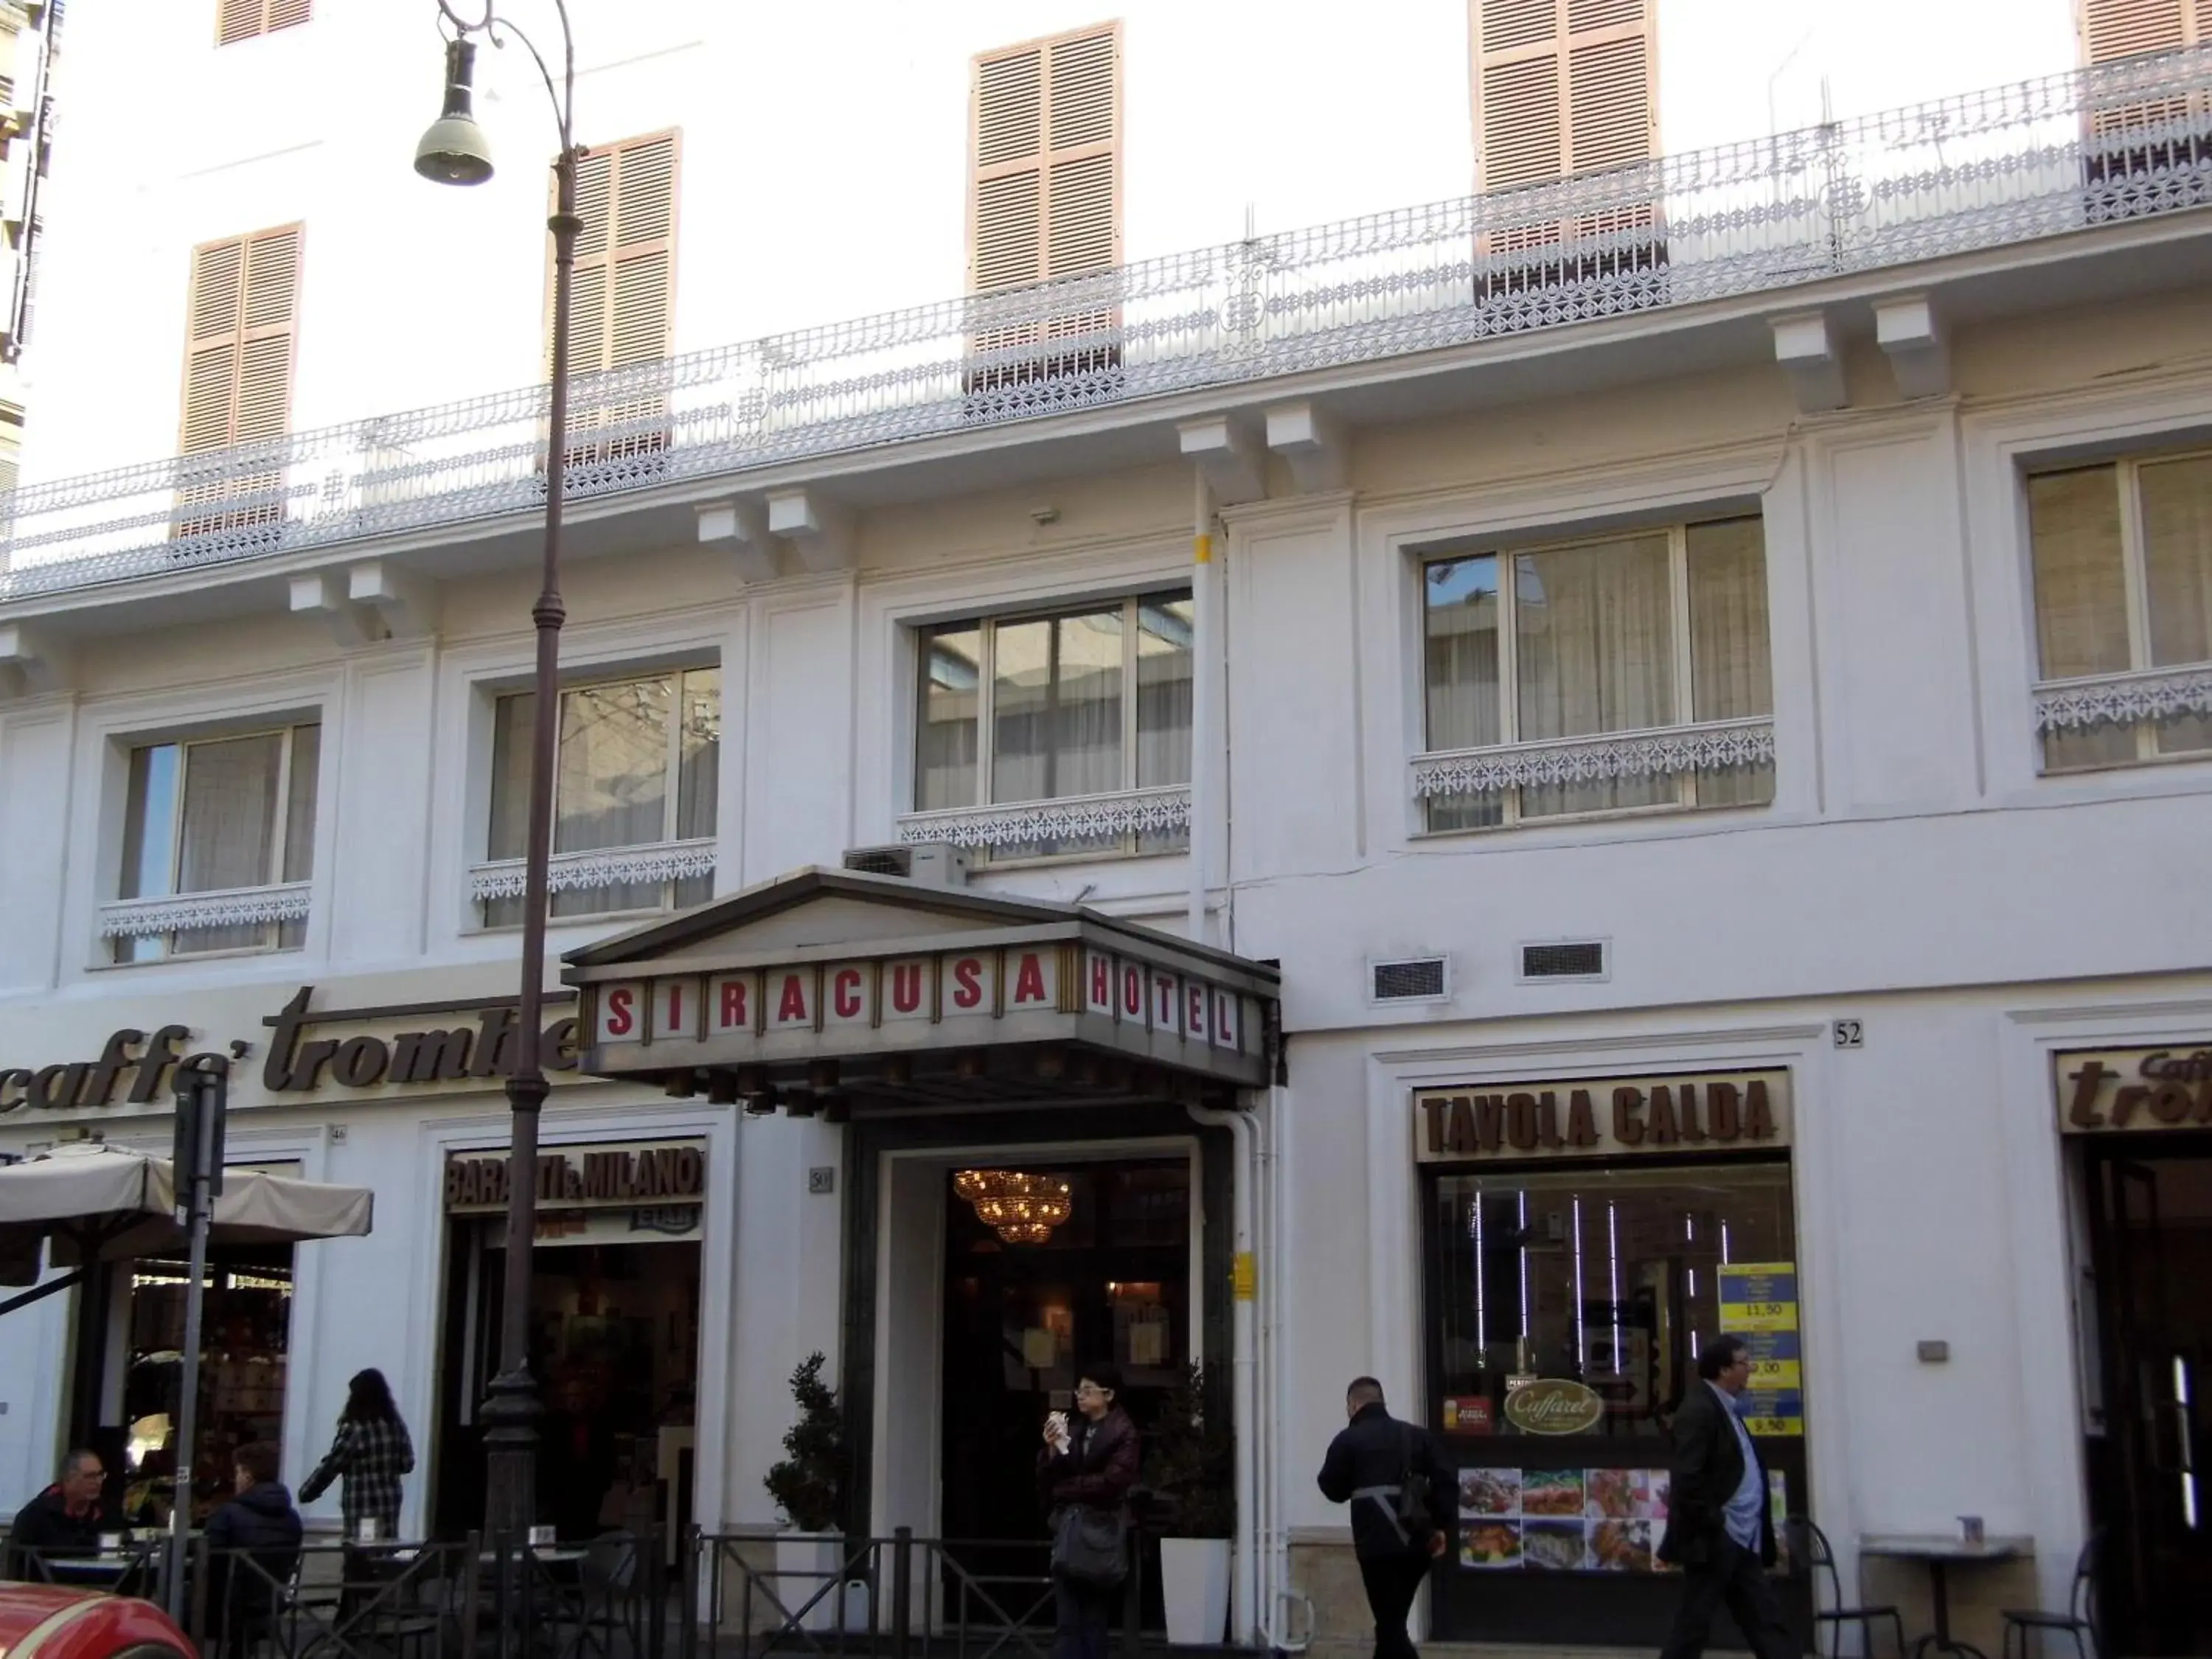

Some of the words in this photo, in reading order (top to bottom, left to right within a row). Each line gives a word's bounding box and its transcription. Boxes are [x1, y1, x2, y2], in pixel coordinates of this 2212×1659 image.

[607, 953, 1046, 1035] SIRACUSA
[1091, 956, 1233, 1041] HOTEL
[1837, 1022, 1860, 1044] 52
[1422, 1088, 1599, 1152] TAVOLA
[1613, 1079, 1778, 1144] CALDA
